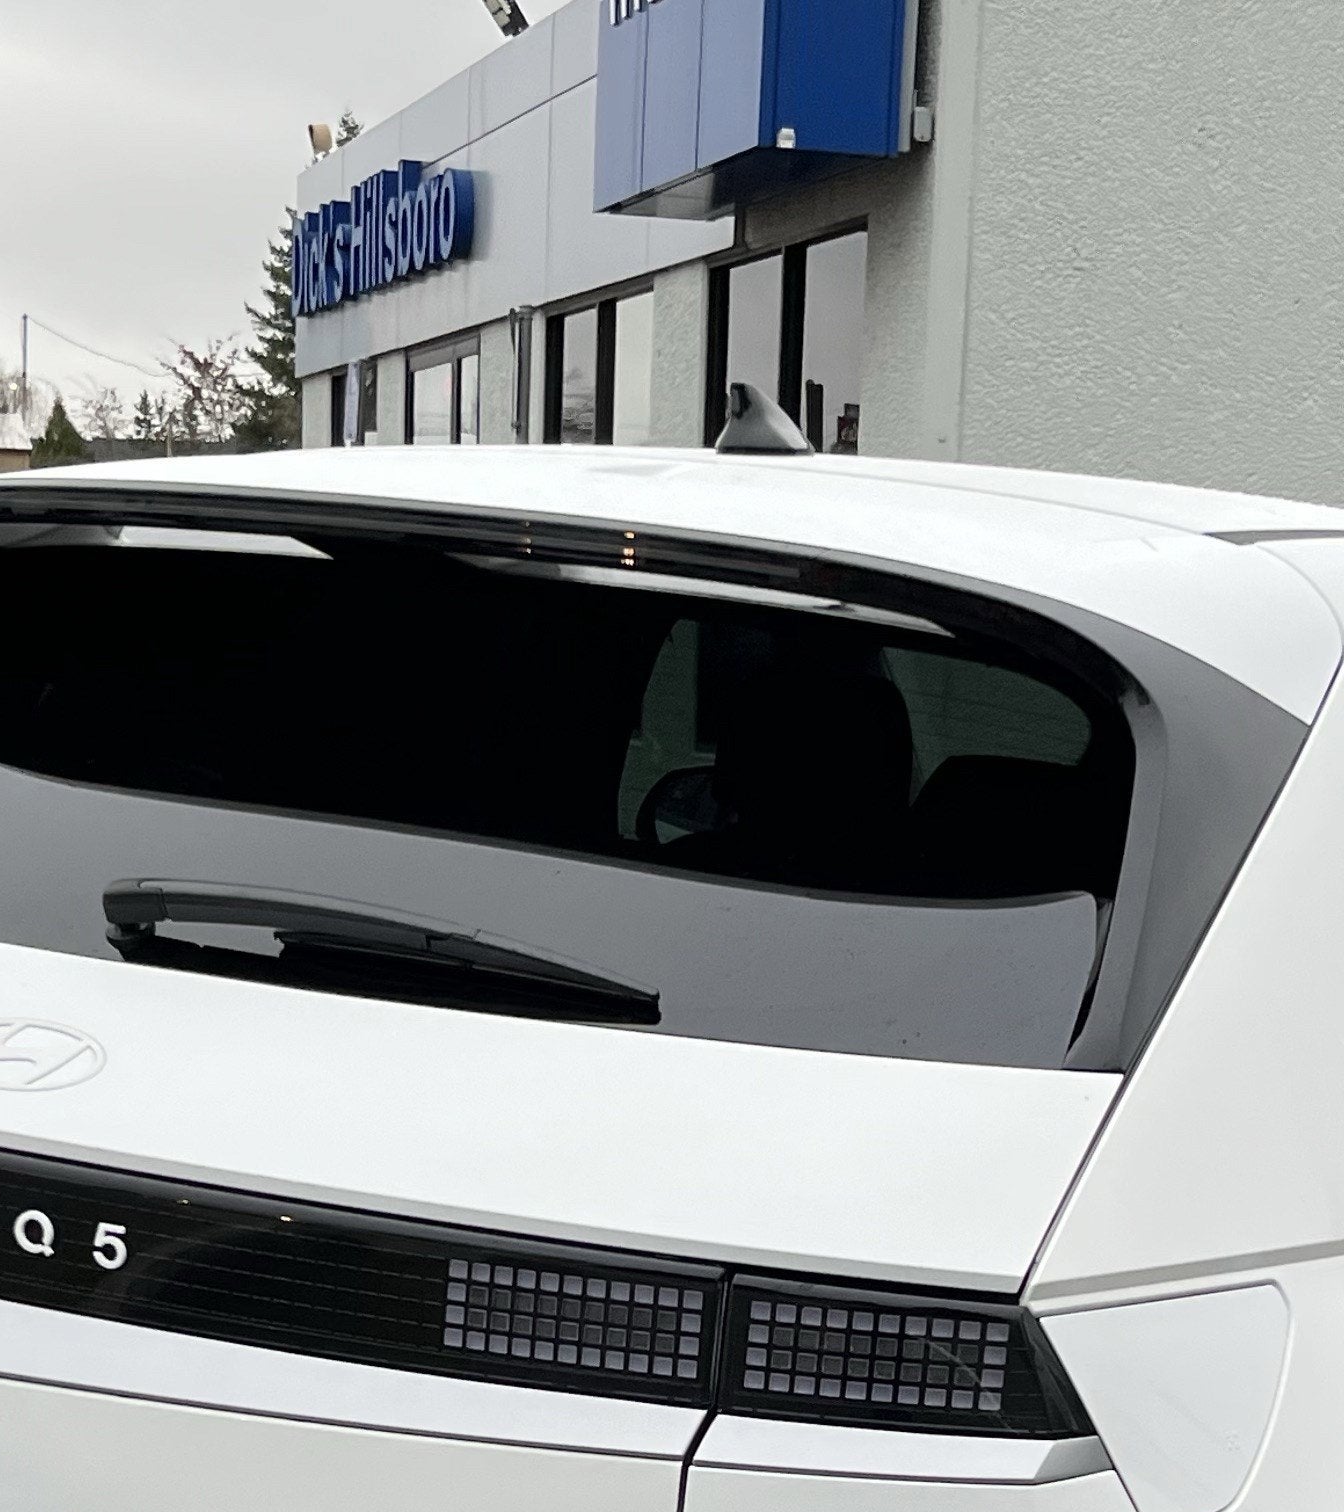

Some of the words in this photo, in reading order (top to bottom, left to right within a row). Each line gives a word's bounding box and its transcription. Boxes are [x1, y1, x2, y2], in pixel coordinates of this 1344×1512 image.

[291, 201, 344, 318] Dick's
[350, 159, 456, 296] Hillsboro
[92, 1222, 128, 1271] 5
